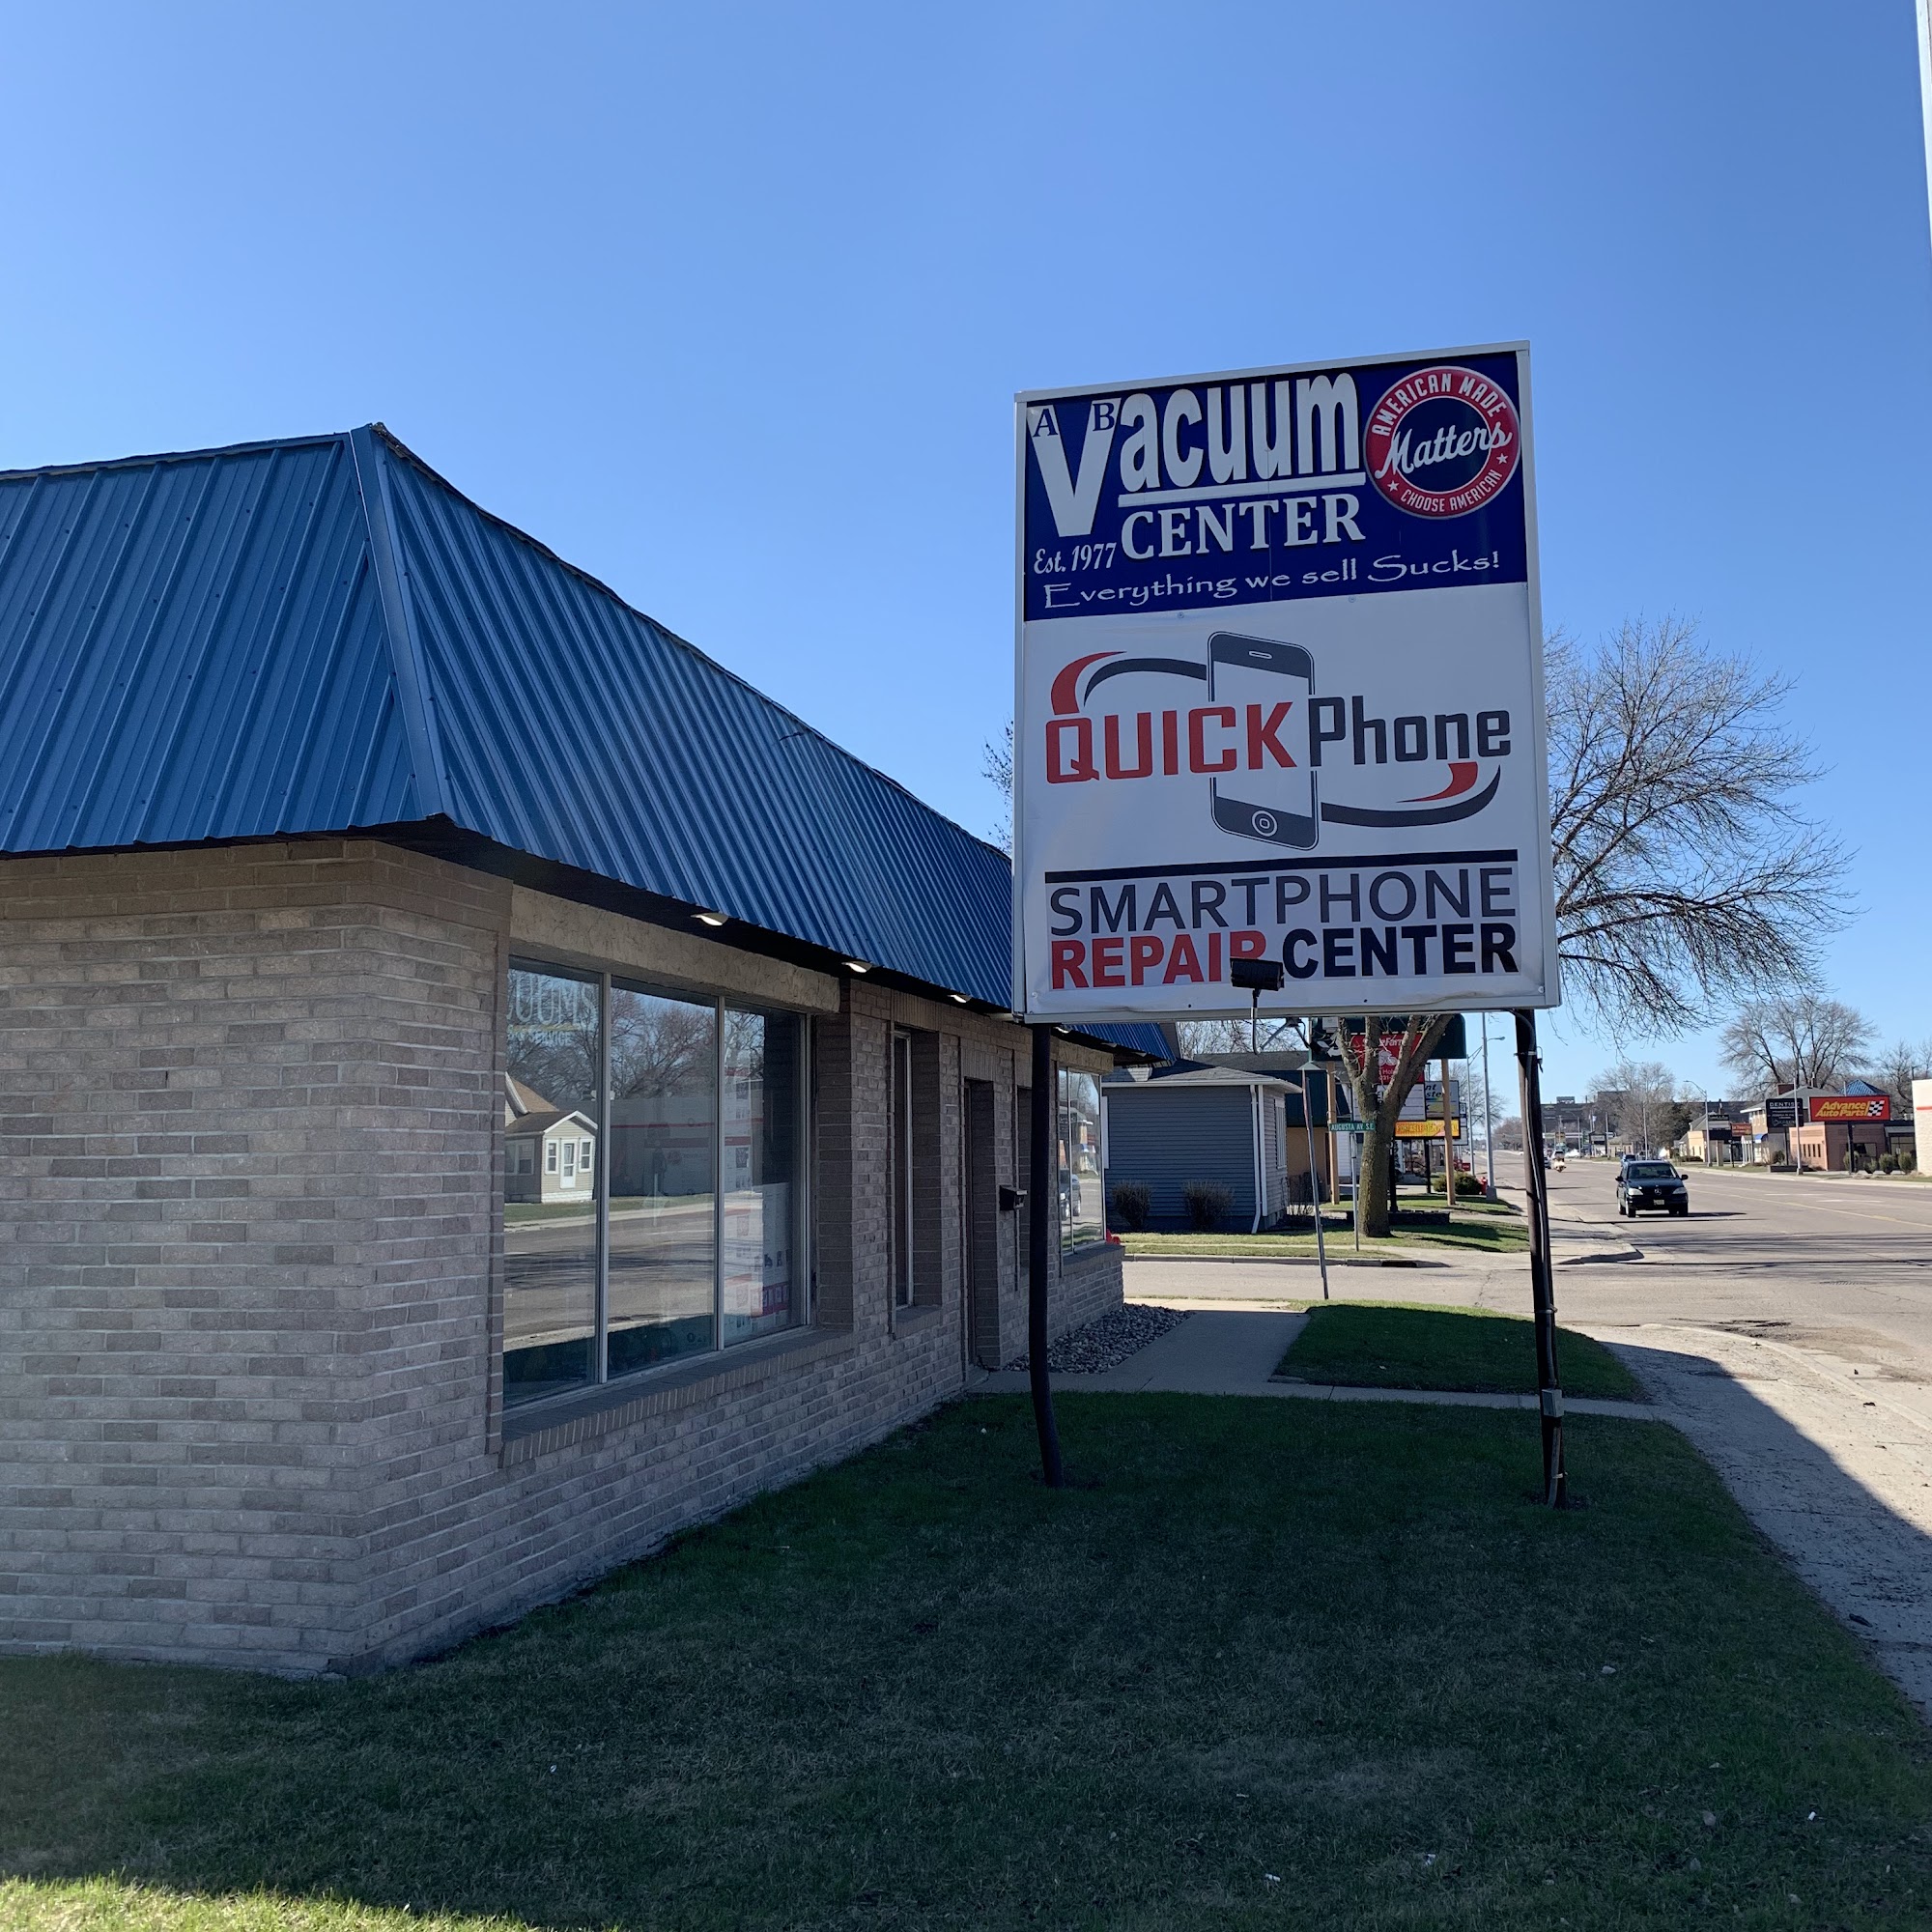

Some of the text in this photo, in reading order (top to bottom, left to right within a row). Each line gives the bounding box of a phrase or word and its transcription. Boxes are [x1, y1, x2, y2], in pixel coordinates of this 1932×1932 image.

[1032, 402, 1117, 438] A B
[1372, 373, 1507, 437] AMERICAN MADE
[1026, 372, 1360, 538] Vacuum
[1374, 421, 1513, 479] Matters
[1401, 469, 1502, 512] CHOOSE AMERICAN
[1121, 494, 1366, 560] CENTER
[1033, 542, 1117, 575] Est. 1977
[1044, 550, 1500, 611] Everything we sell Sucks!
[1045, 695, 1512, 784] QUICK Phone
[1050, 867, 1517, 937] SMARTPHONE
[1282, 922, 1520, 980] CENTER
[1822, 1101, 1865, 1110] Advance
